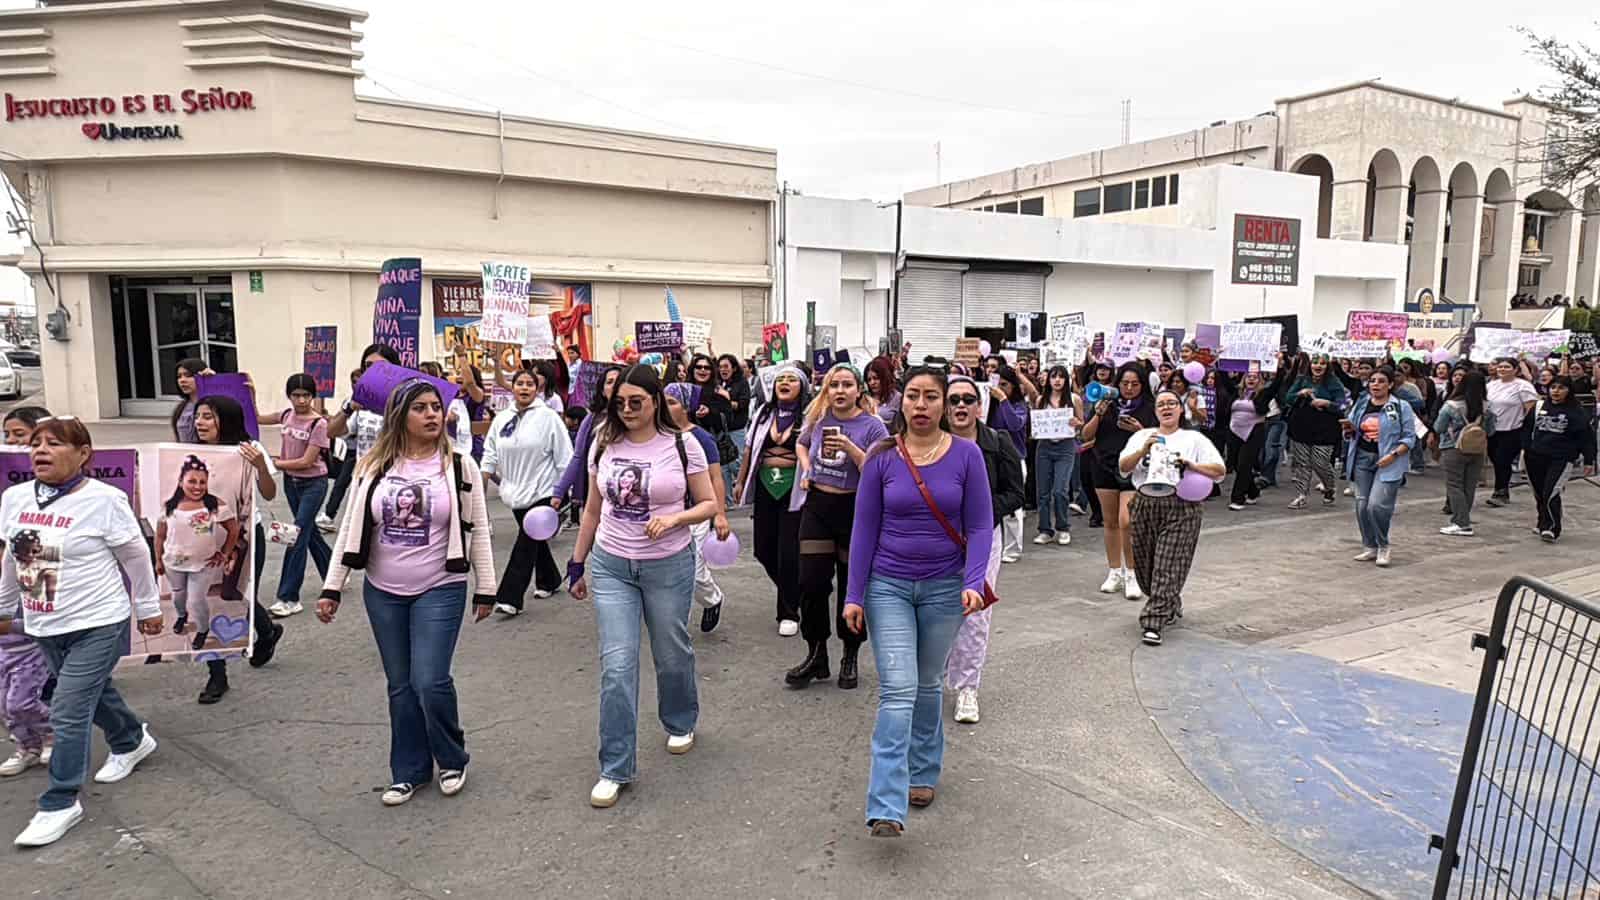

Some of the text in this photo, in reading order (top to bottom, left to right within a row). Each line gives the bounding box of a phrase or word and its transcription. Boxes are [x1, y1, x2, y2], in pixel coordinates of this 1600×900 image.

[5, 87, 256, 121] JESUCRISTO ES EL SEÑOR
[100, 122, 183, 141] UNIVERSAL
[1245, 219, 1290, 243] RENTA
[398, 268, 421, 284] QUE
[443, 286, 483, 299] VIERNES
[443, 300, 448, 312] 3
[450, 300, 459, 312] DE
[461, 300, 481, 312] ABRIL
[19, 512, 74, 529] MAMÁ DE
